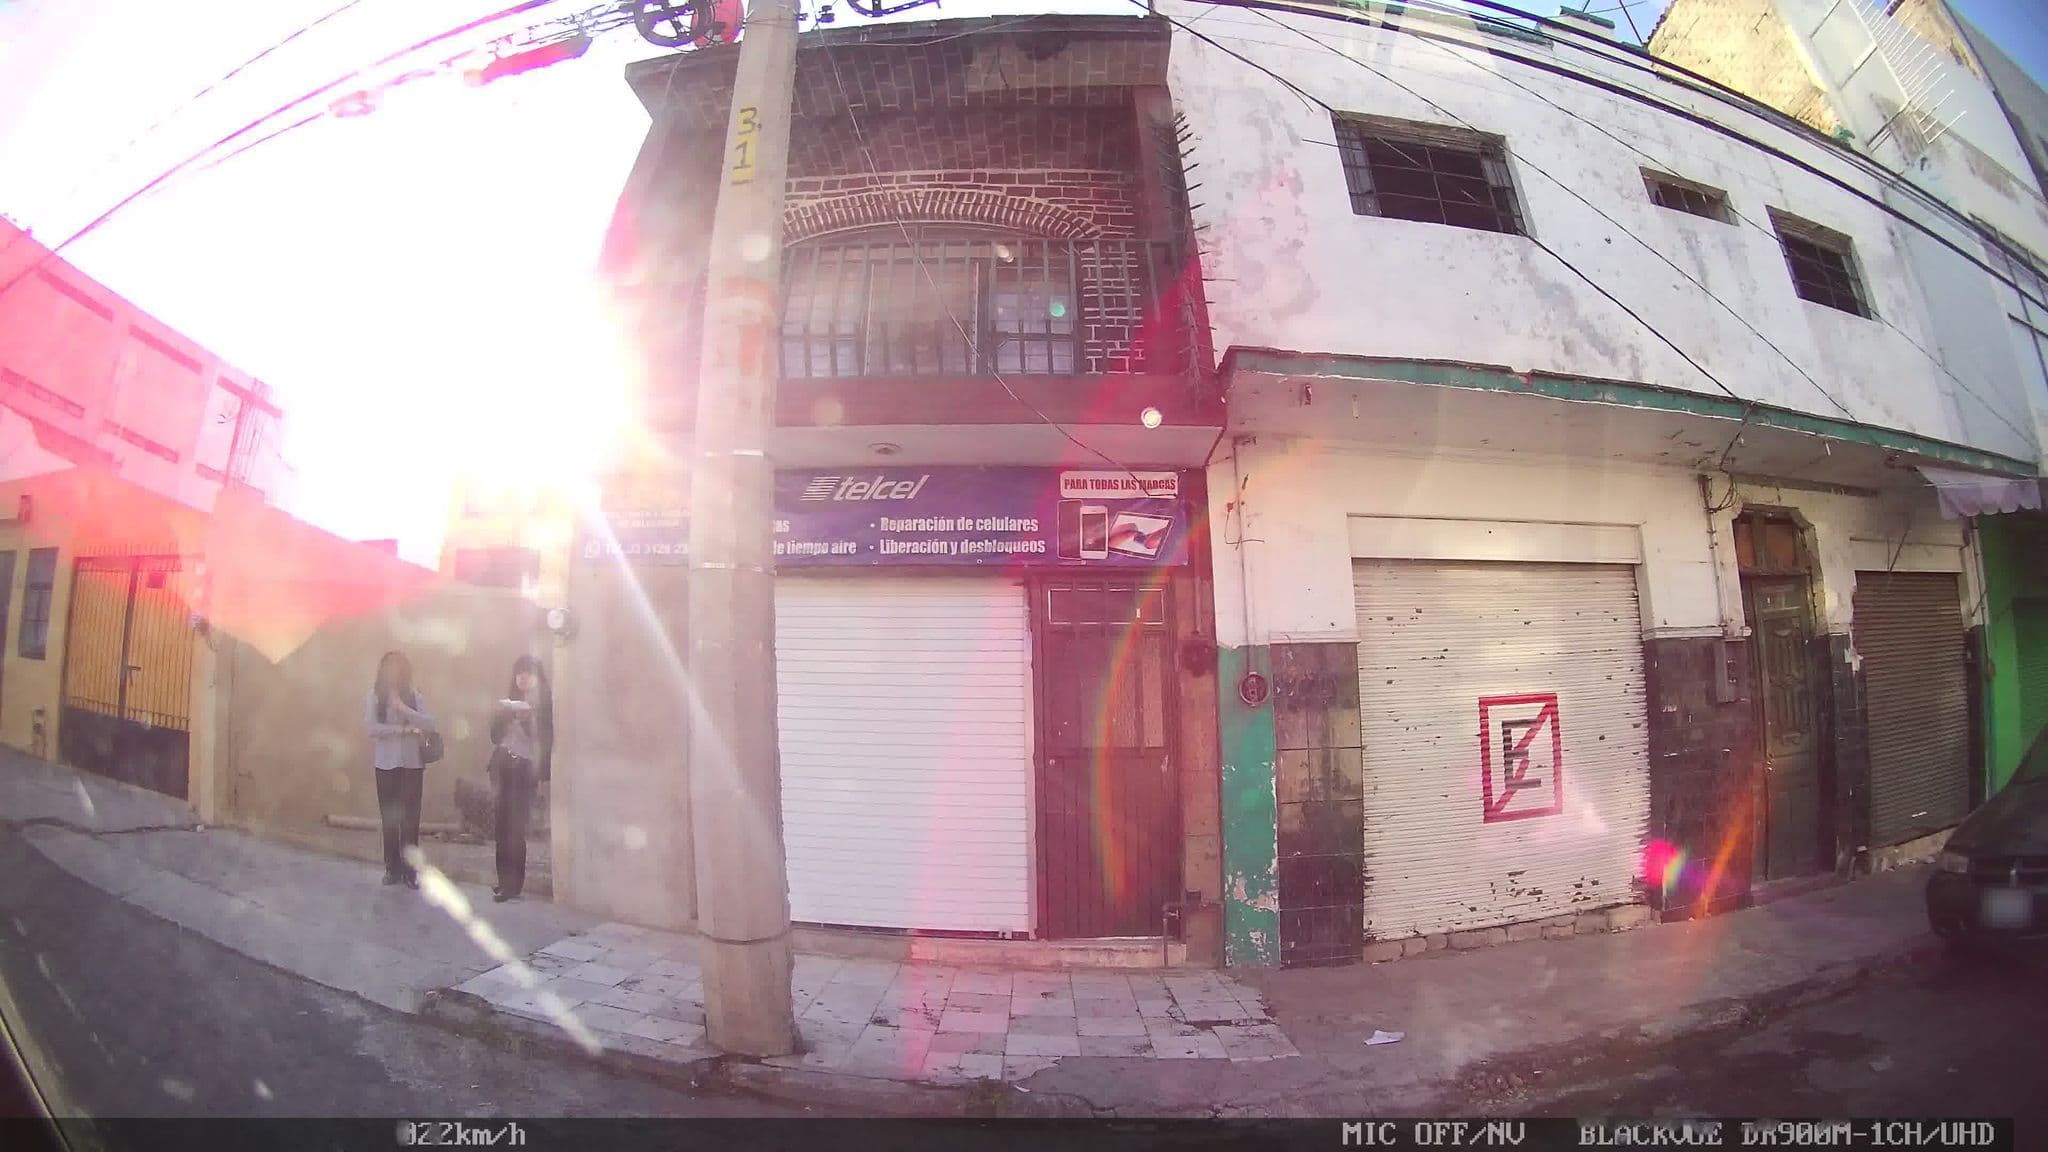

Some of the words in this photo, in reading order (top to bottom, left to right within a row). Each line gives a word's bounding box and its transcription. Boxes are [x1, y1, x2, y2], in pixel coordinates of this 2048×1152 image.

[833, 474, 930, 501] telcel
[1064, 479, 1088, 490] PARA
[1089, 479, 1119, 490] TODAS
[1121, 479, 1137, 490] LAS
[1139, 479, 1176, 490] MARCAS
[773, 519, 790, 533] as
[880, 517, 954, 533] Reparación
[956, 516, 973, 531] de
[975, 517, 1039, 532] celulares
[786, 540, 829, 556] tiempo
[831, 541, 857, 555] aire
[879, 539, 948, 555] Liberación
[950, 542, 958, 556] y
[960, 539, 1046, 554] desbloqueos
[1502, 718, 1541, 790] E
